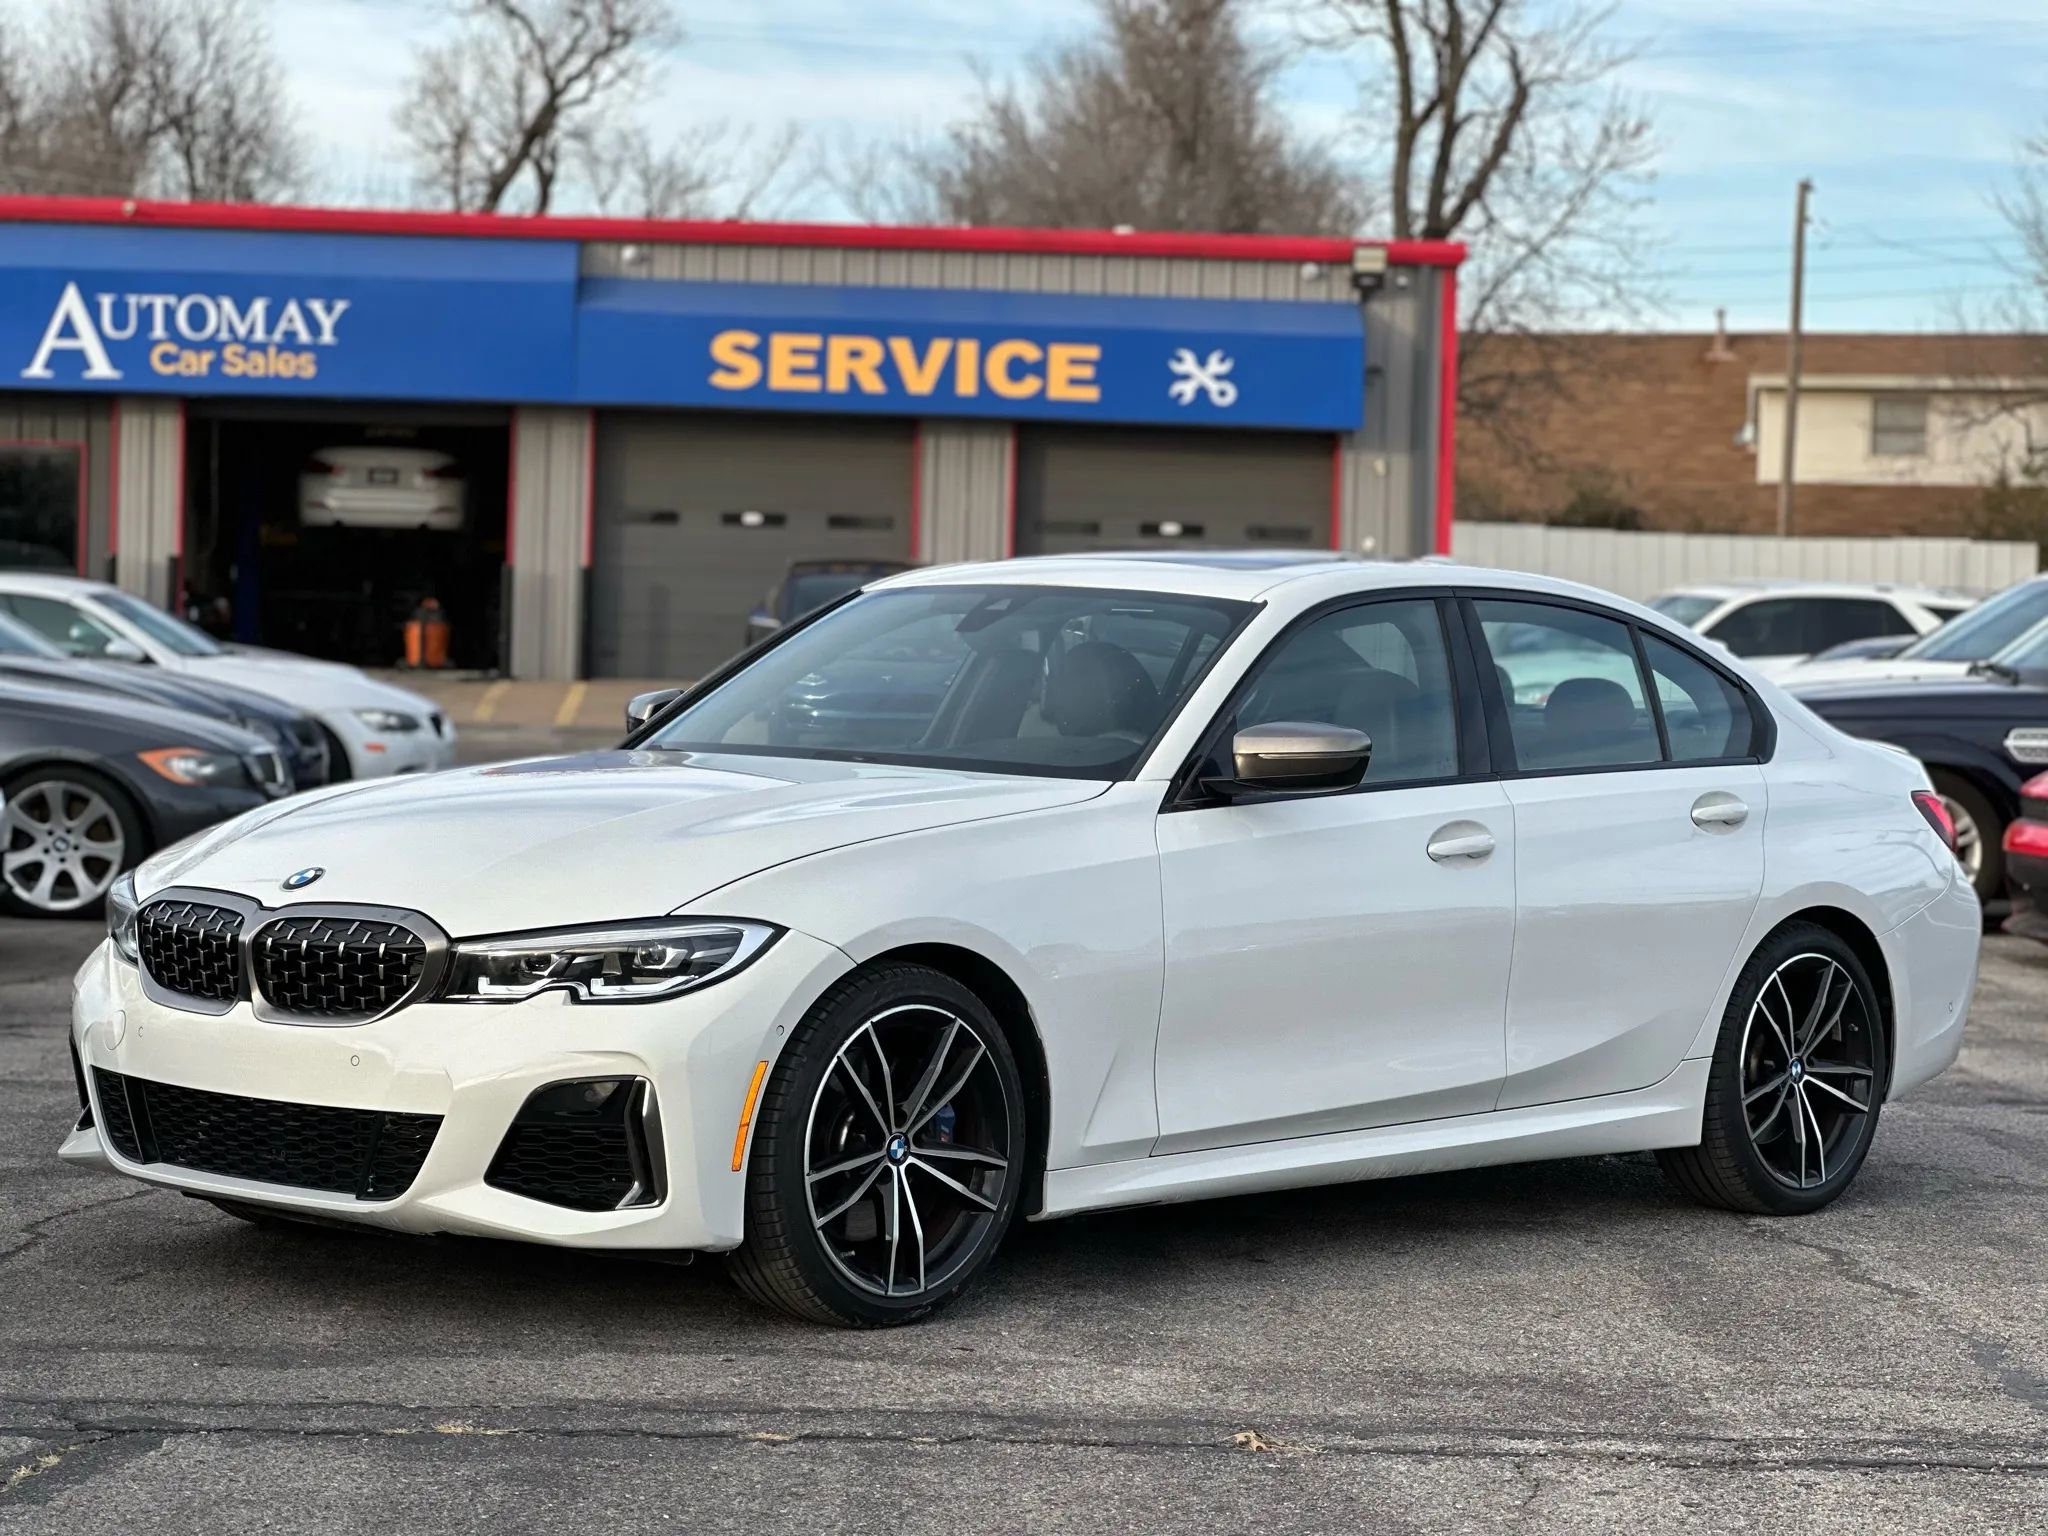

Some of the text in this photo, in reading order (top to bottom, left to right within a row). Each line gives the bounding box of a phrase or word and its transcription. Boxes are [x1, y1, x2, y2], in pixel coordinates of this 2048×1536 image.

[20, 281, 351, 380] AUTOMAY
[149, 341, 317, 379] Car Sales
[709, 329, 1102, 403] SERVICE
